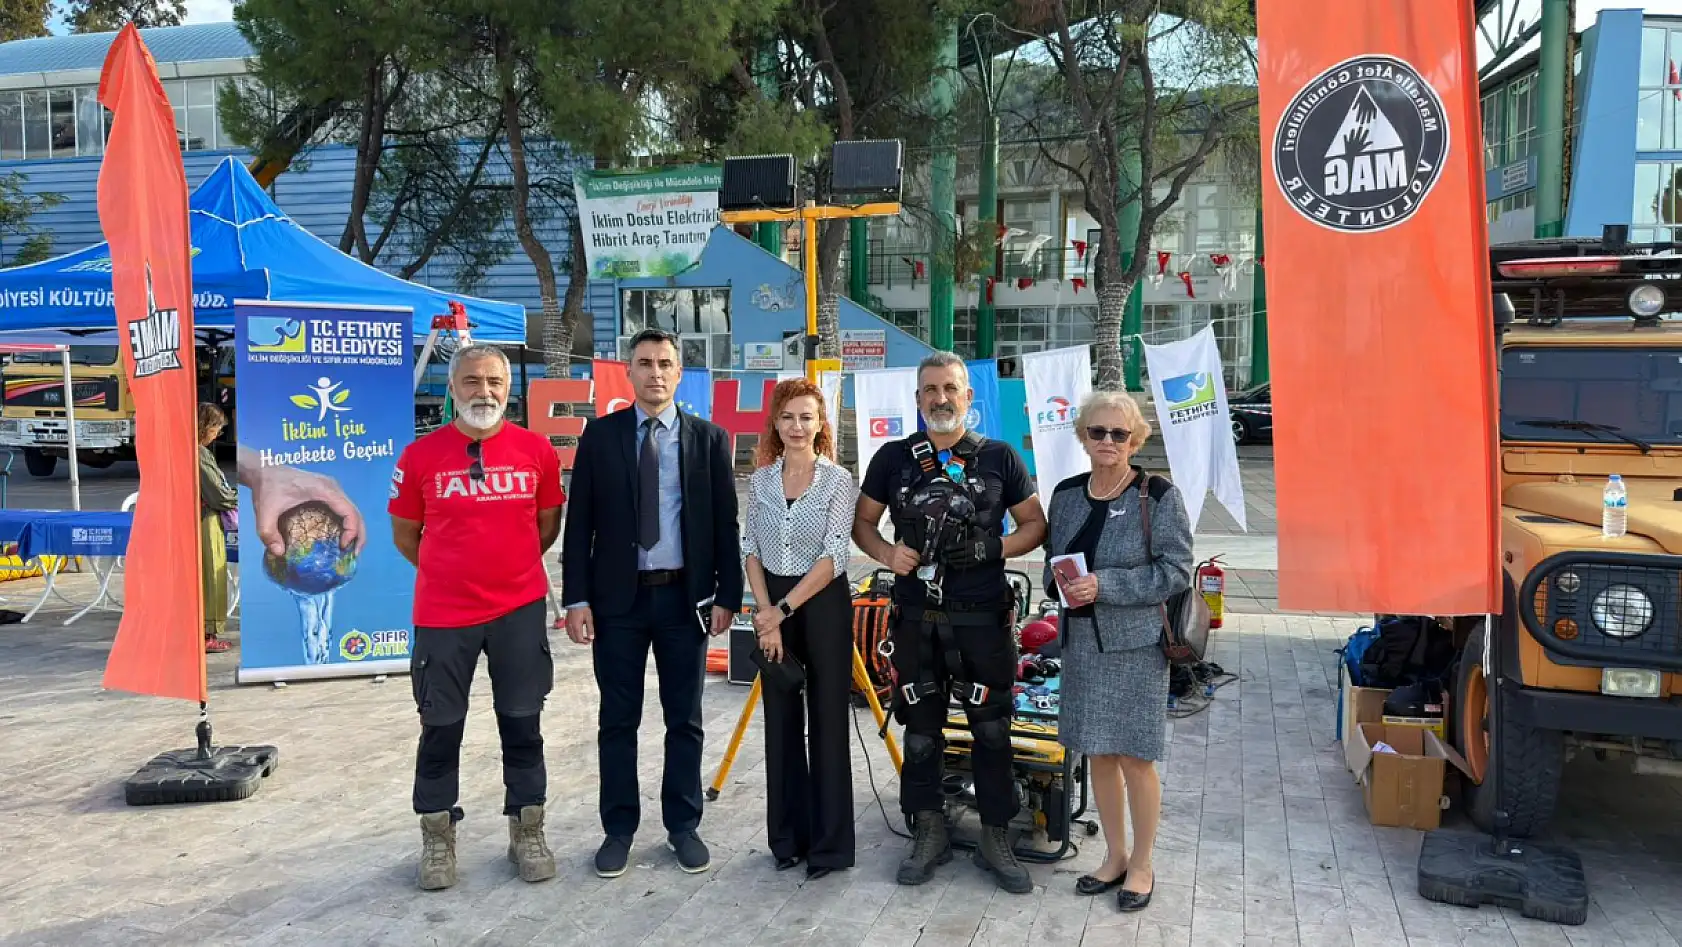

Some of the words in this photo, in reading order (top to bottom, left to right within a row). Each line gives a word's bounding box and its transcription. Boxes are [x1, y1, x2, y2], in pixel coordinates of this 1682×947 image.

[591, 211, 624, 229] İklim
[626, 211, 664, 228] Dostu
[592, 232, 628, 248] Hibrit
[631, 231, 660, 249] Araç
[310, 320, 335, 337] T.C.
[338, 321, 402, 338] FETHİYE
[310, 337, 403, 356] BELEDİYESİ
[281, 418, 328, 441] İklim
[335, 413, 367, 441] İçin
[259, 445, 336, 468] Harekete
[343, 439, 394, 462] Geçin!
[442, 471, 530, 498] AKUT
[372, 630, 408, 643] SIFIR
[372, 642, 409, 656] ATIK
